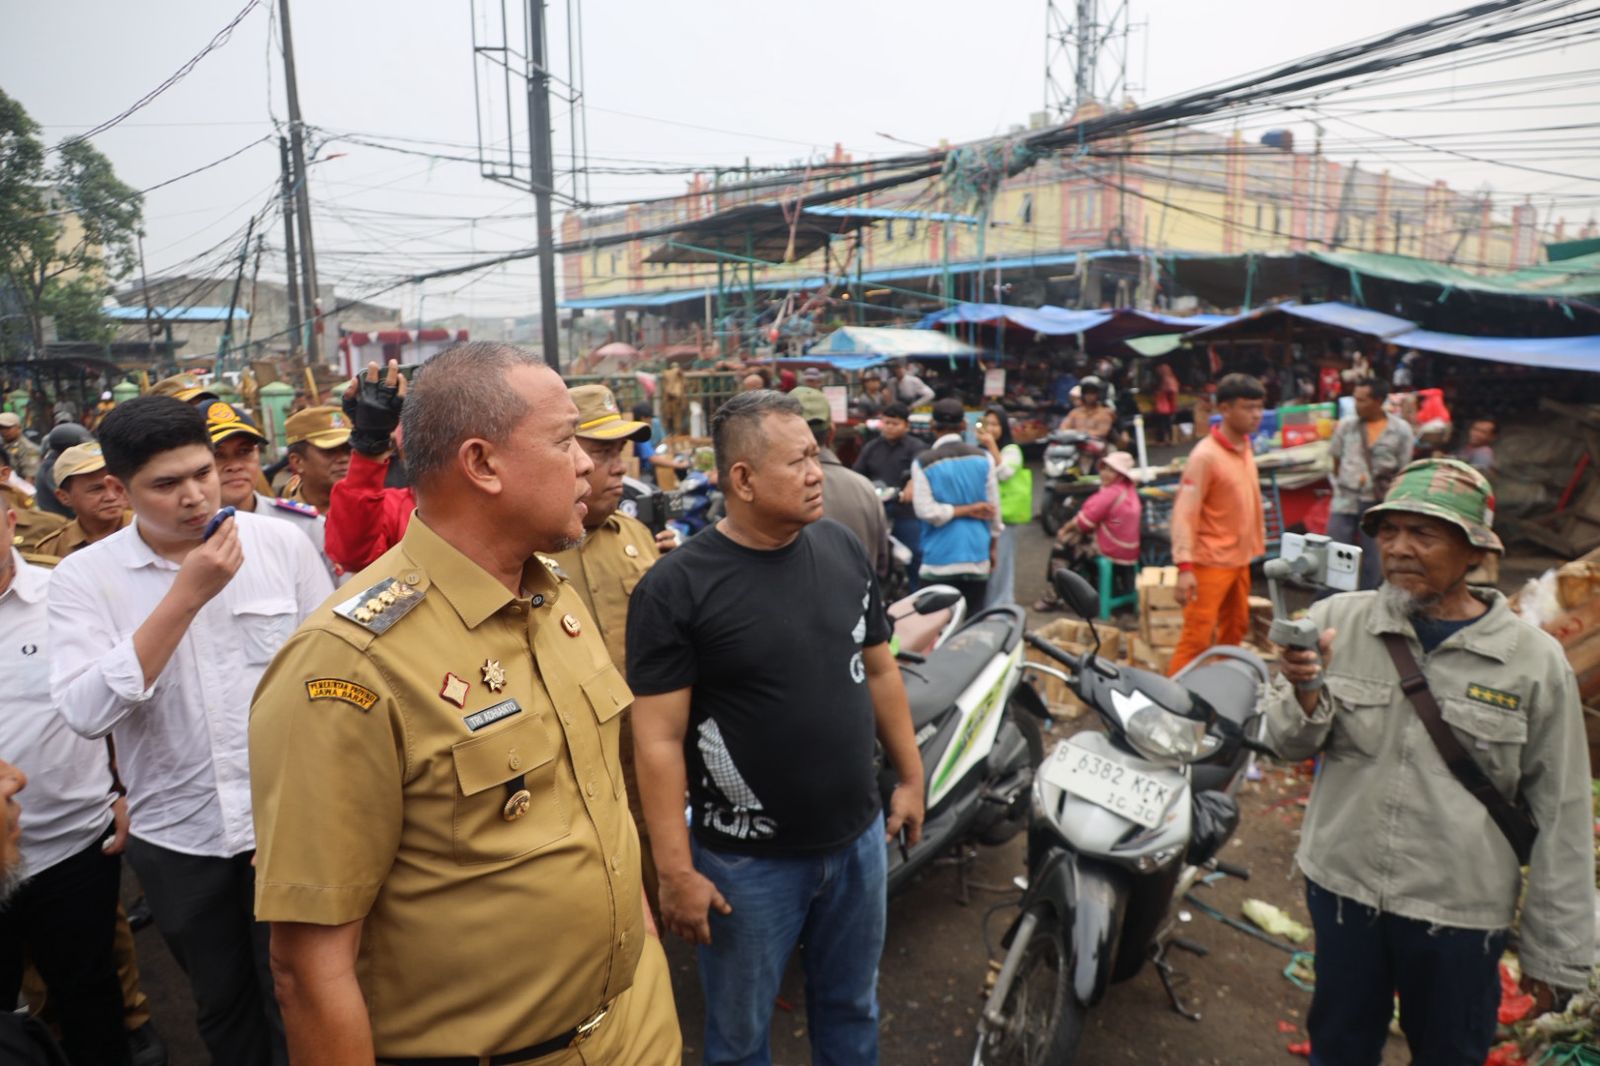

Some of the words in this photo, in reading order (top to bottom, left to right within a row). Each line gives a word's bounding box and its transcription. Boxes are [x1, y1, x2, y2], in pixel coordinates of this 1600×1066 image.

[314, 689, 338, 697] JAWA
[469, 715, 484, 727] TRI
[1056, 745, 1070, 763] B
[1078, 754, 1125, 786] 6382
